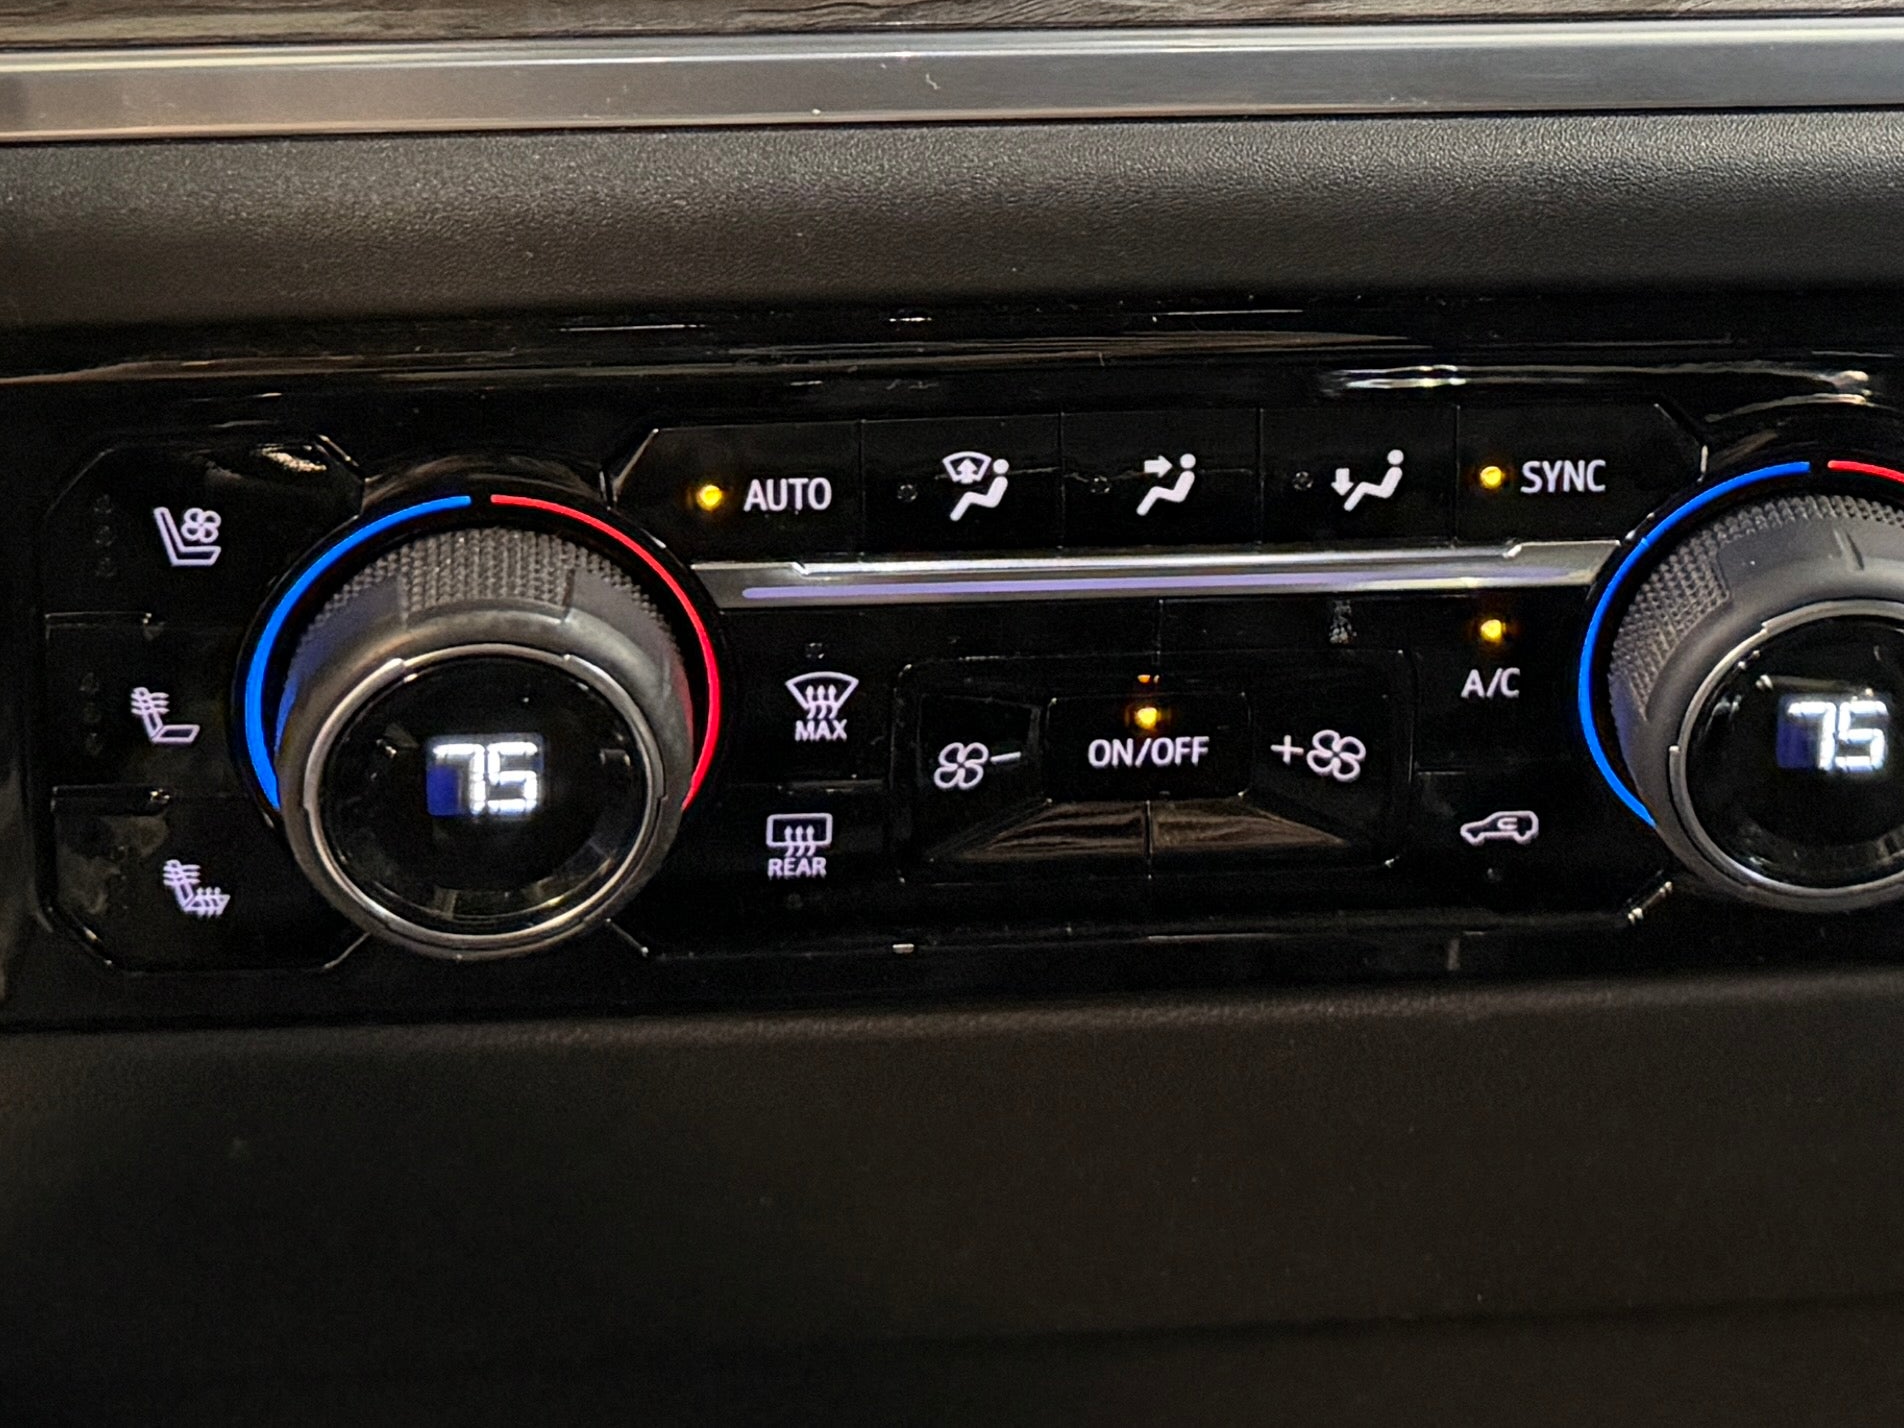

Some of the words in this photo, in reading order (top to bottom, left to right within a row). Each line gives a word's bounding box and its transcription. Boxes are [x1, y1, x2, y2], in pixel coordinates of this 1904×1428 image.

[1520, 459, 1607, 494] SYNC
[743, 477, 833, 515] AUTO
[1460, 667, 1521, 700] A/C
[794, 718, 849, 742] MAX
[1786, 699, 1889, 773] 75
[1087, 734, 1210, 768] ON/OFF
[432, 741, 541, 815] 75
[766, 855, 828, 880] REAR
